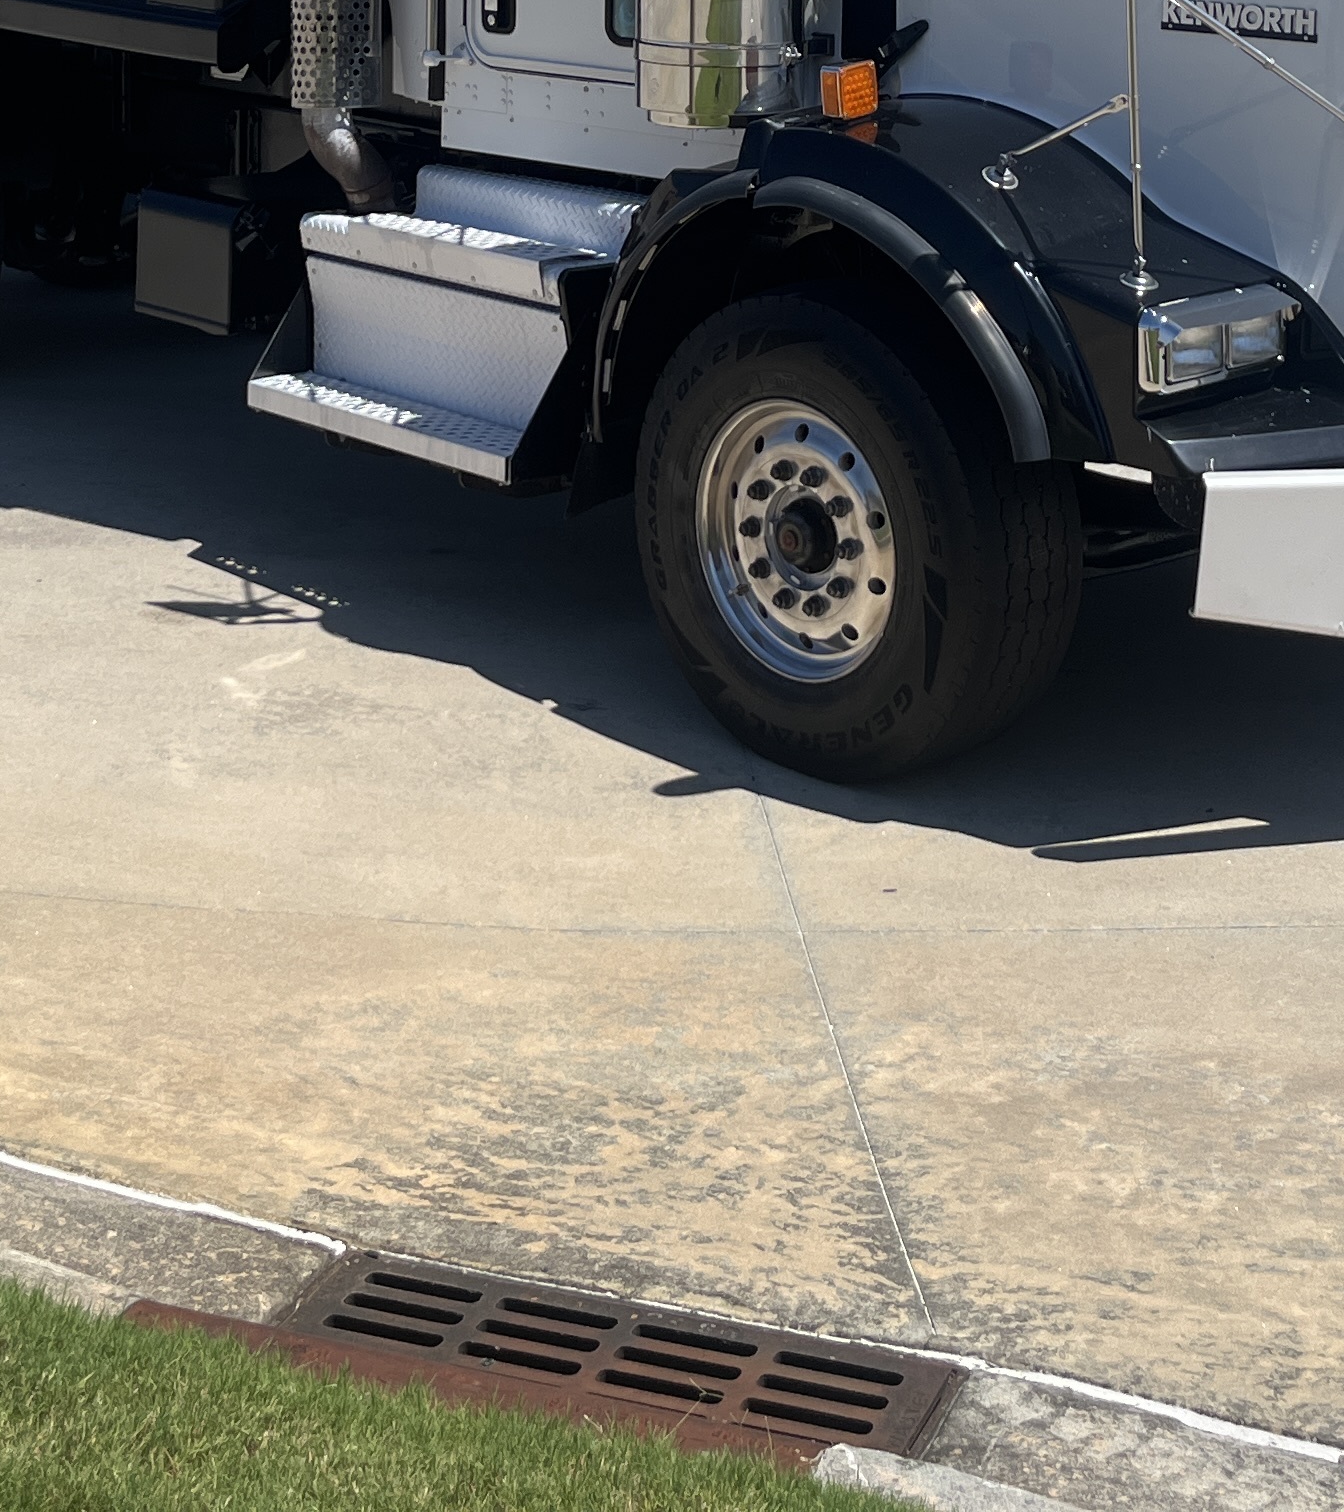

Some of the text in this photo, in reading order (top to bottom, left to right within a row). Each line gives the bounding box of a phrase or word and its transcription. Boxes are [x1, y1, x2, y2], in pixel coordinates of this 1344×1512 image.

[647, 408, 673, 592] GRABBER
[712, 341, 729, 365] 2
[748, 682, 914, 752] GENERAL
